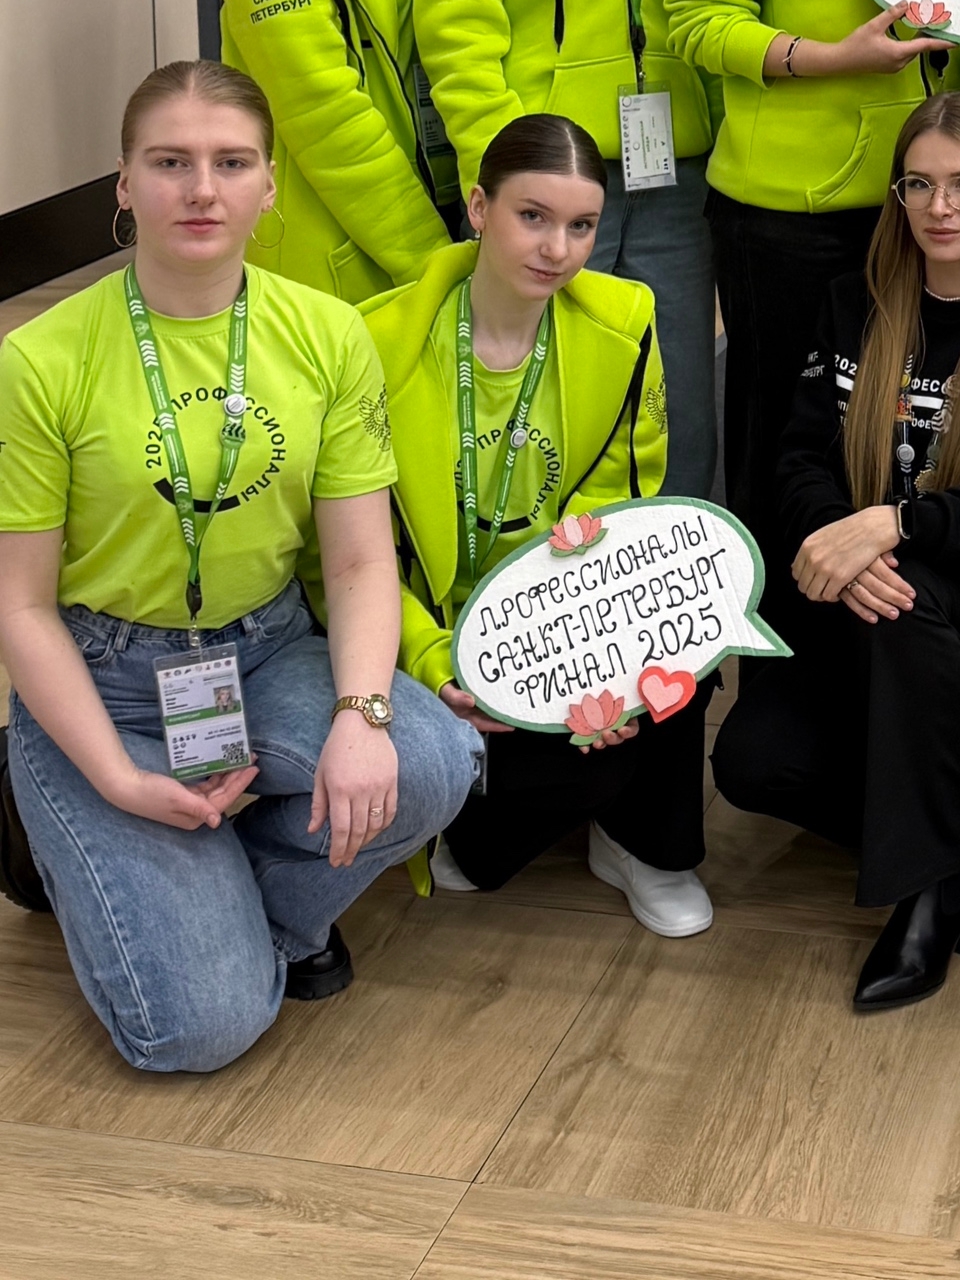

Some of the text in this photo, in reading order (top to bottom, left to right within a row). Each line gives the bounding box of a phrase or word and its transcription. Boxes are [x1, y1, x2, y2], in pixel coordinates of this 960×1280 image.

[170, 386, 287, 502] ПРОФССИОНАЛЫ
[477, 548, 727, 684] САНКТ-ПЕТЕРБУРГ
[479, 515, 709, 637] ПРОФЕССИОНАЛЫ
[513, 602, 723, 709] ФИНАЛ 2025
